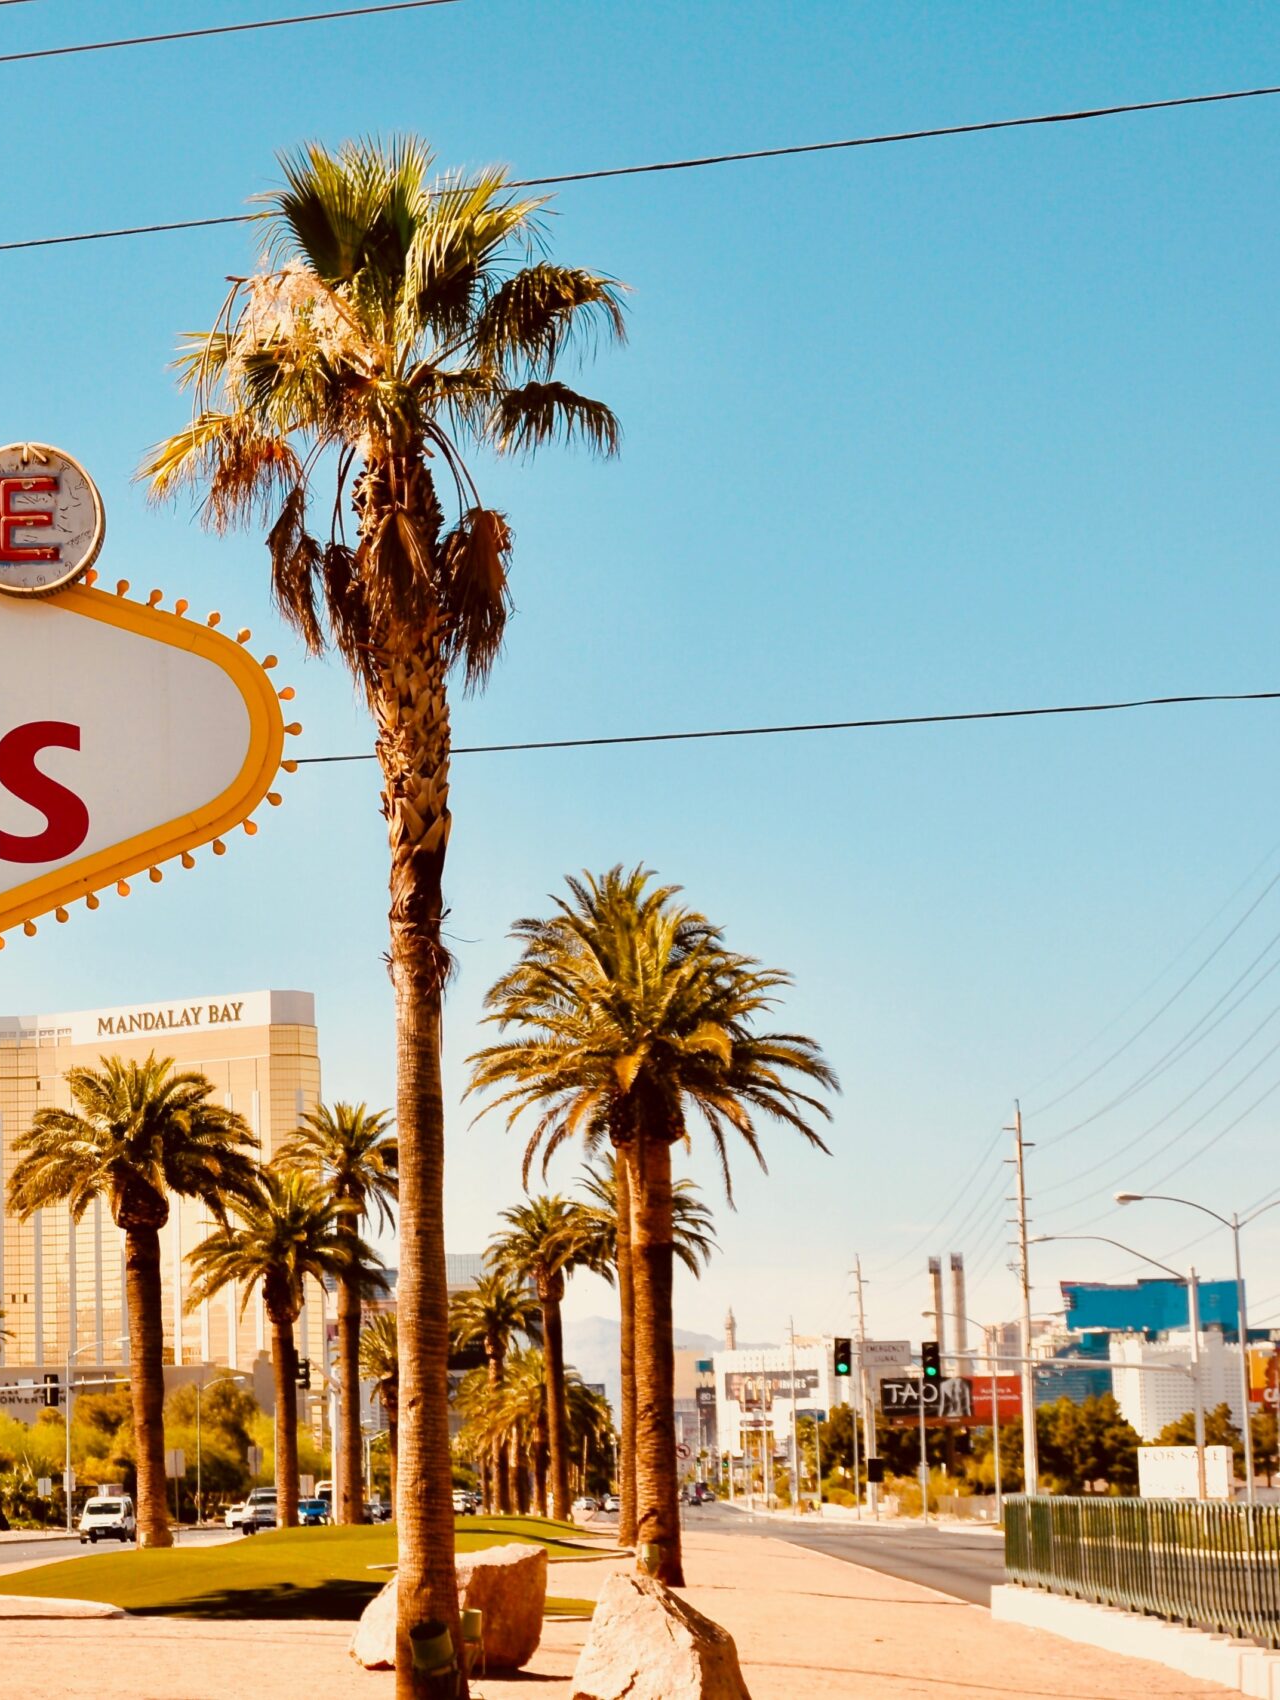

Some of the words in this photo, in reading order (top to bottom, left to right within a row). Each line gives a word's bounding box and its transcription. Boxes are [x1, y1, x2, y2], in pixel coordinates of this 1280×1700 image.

[97, 1006, 202, 1036] MANDALAY
[208, 1002, 244, 1024] BAY
[883, 1383, 938, 1404] TAO
